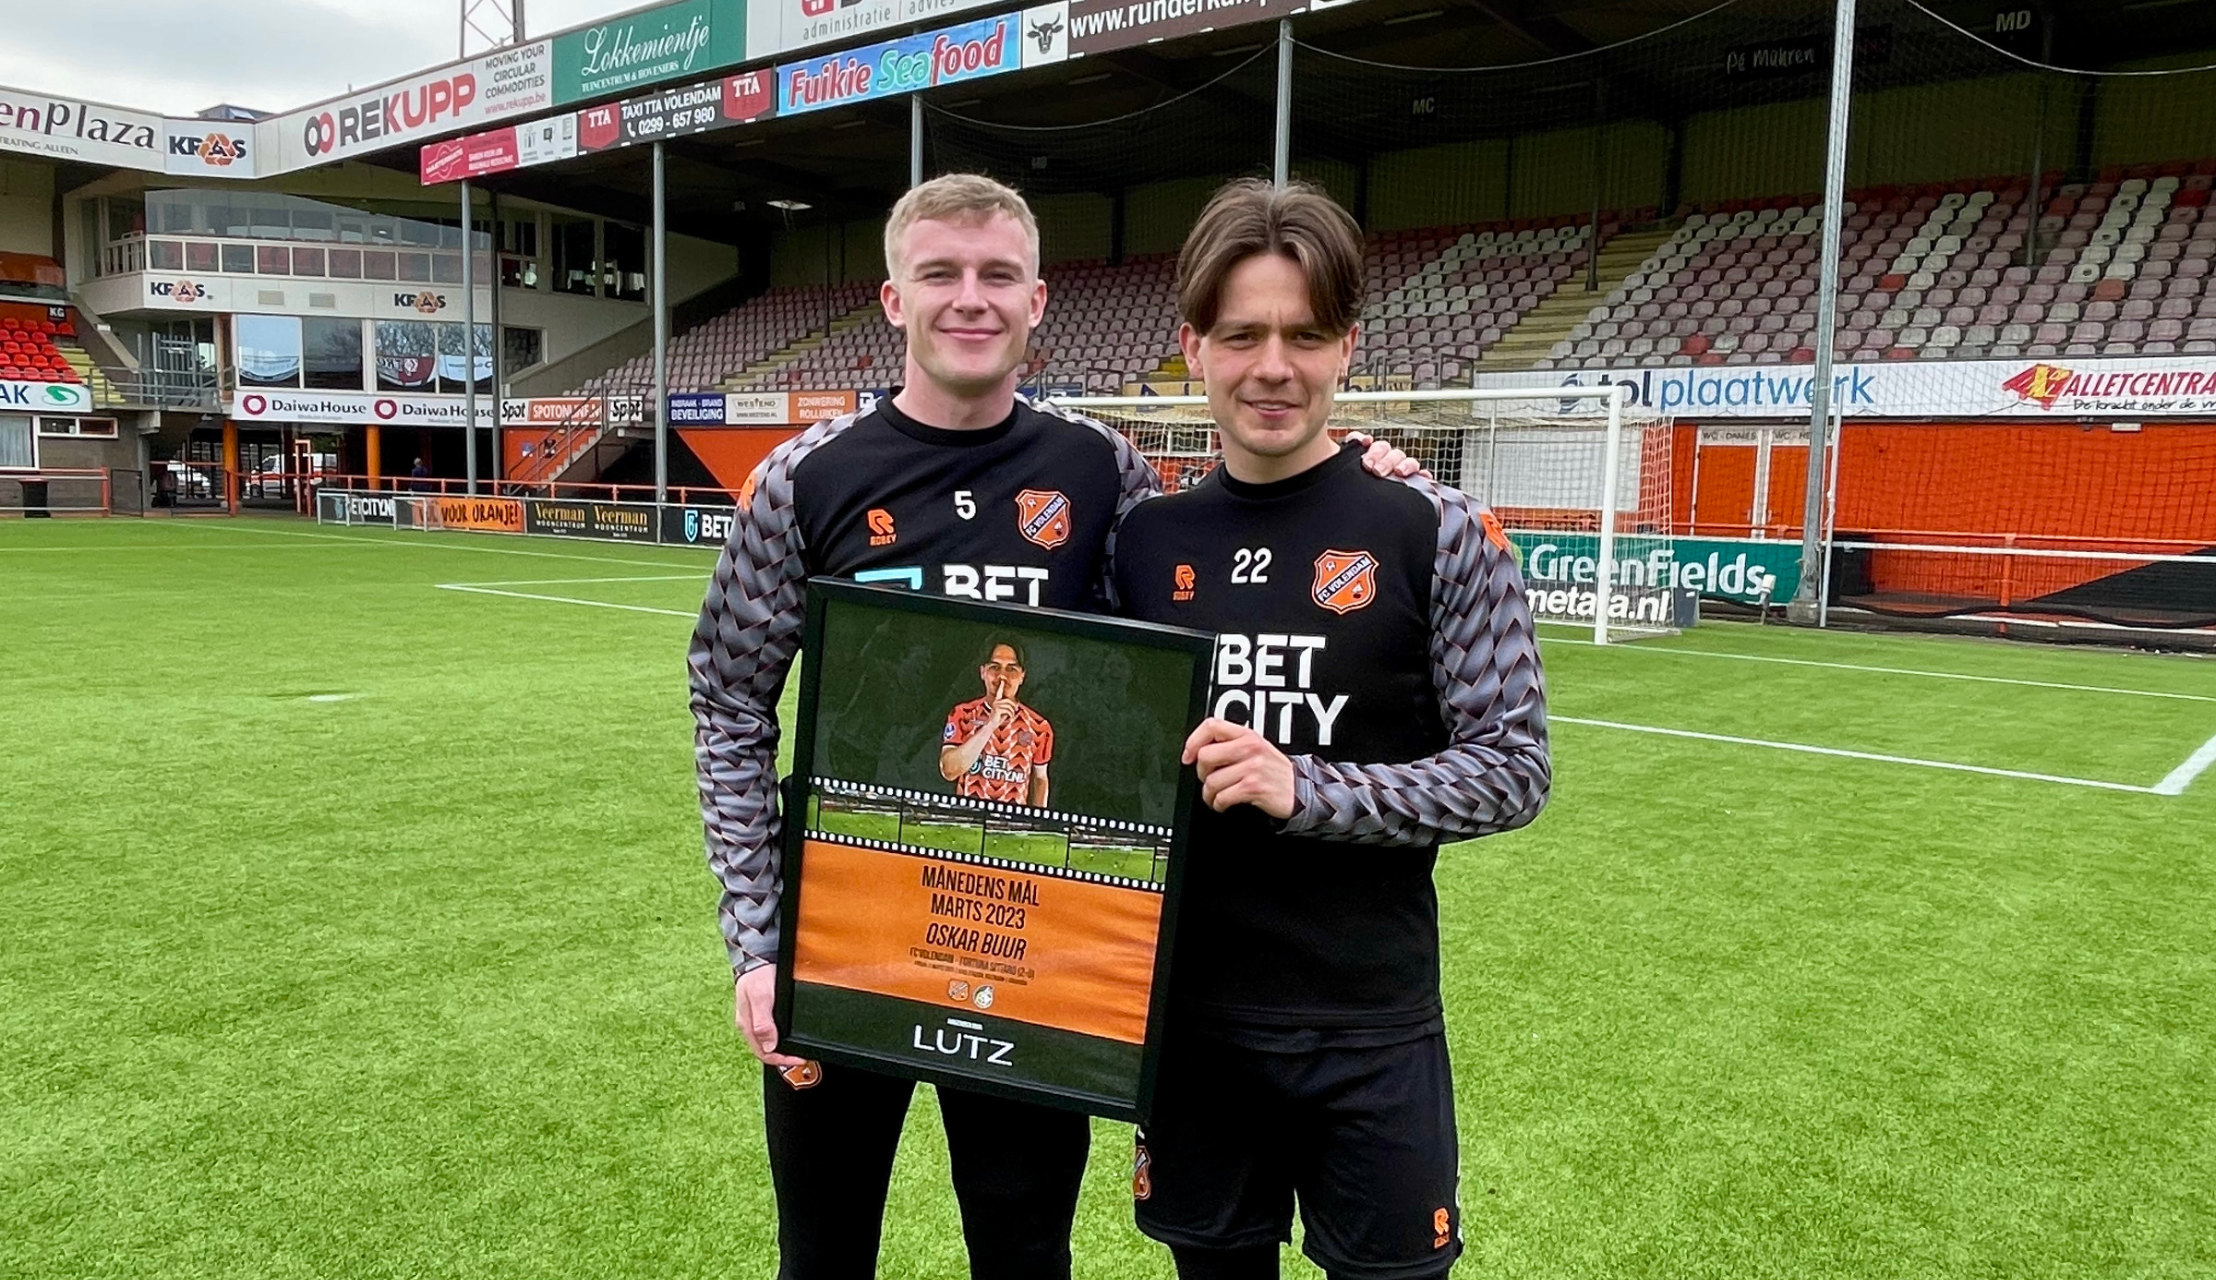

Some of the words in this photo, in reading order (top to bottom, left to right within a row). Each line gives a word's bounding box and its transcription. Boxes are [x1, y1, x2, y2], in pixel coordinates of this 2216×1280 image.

[803, 7, 891, 40] administratie
[1995, 10, 2031, 32] MD
[485, 51, 519, 70] MOVING
[520, 44, 545, 61] YOUR
[788, 58, 871, 109] Fuikie
[876, 21, 1007, 91] Seafood
[494, 62, 536, 83] CIRCULAR
[638, 61, 679, 78] HOVENIERS
[485, 74, 545, 99] COMMODITIES
[732, 75, 761, 98] TTA
[340, 73, 476, 147] REKUPP
[484, 92, 546, 115] www.rekupp.be
[621, 104, 643, 120] TAXI
[644, 98, 663, 115] TTA
[664, 85, 722, 111] VOLENDAM
[1412, 96, 1435, 115] MC
[588, 109, 612, 128] TTA
[638, 116, 664, 135] 0299
[672, 110, 692, 129] 657
[695, 106, 715, 125] 980
[169, 135, 246, 159] KRAS
[50, 307, 65, 318] KG
[1660, 366, 1876, 414] plaatwerk
[272, 399, 318, 412] Daiwa
[320, 401, 367, 414] House
[402, 403, 448, 416] Daiwa
[502, 400, 526, 422] Spot
[613, 400, 641, 421] Spot
[671, 408, 724, 420] BEVEILIGING
[472, 503, 518, 526] ORANJE!
[535, 502, 586, 521] Veerman
[594, 505, 648, 526] Veerman
[954, 490, 976, 520] 5
[702, 514, 732, 539] BET
[1231, 547, 1272, 584] 22
[943, 563, 1049, 608] BET
[1217, 633, 1326, 689] BET
[1213, 689, 1350, 746] CITY
[984, 755, 1009, 769] BET
[922, 865, 1005, 900] MÅNEDENS
[1008, 880, 1039, 906] MÅL
[931, 893, 983, 922] MARTS
[985, 902, 1026, 930] 2023
[926, 923, 980, 953] OSKAR
[981, 932, 1027, 961] BUUR
[913, 1025, 1015, 1067] LUTZ
